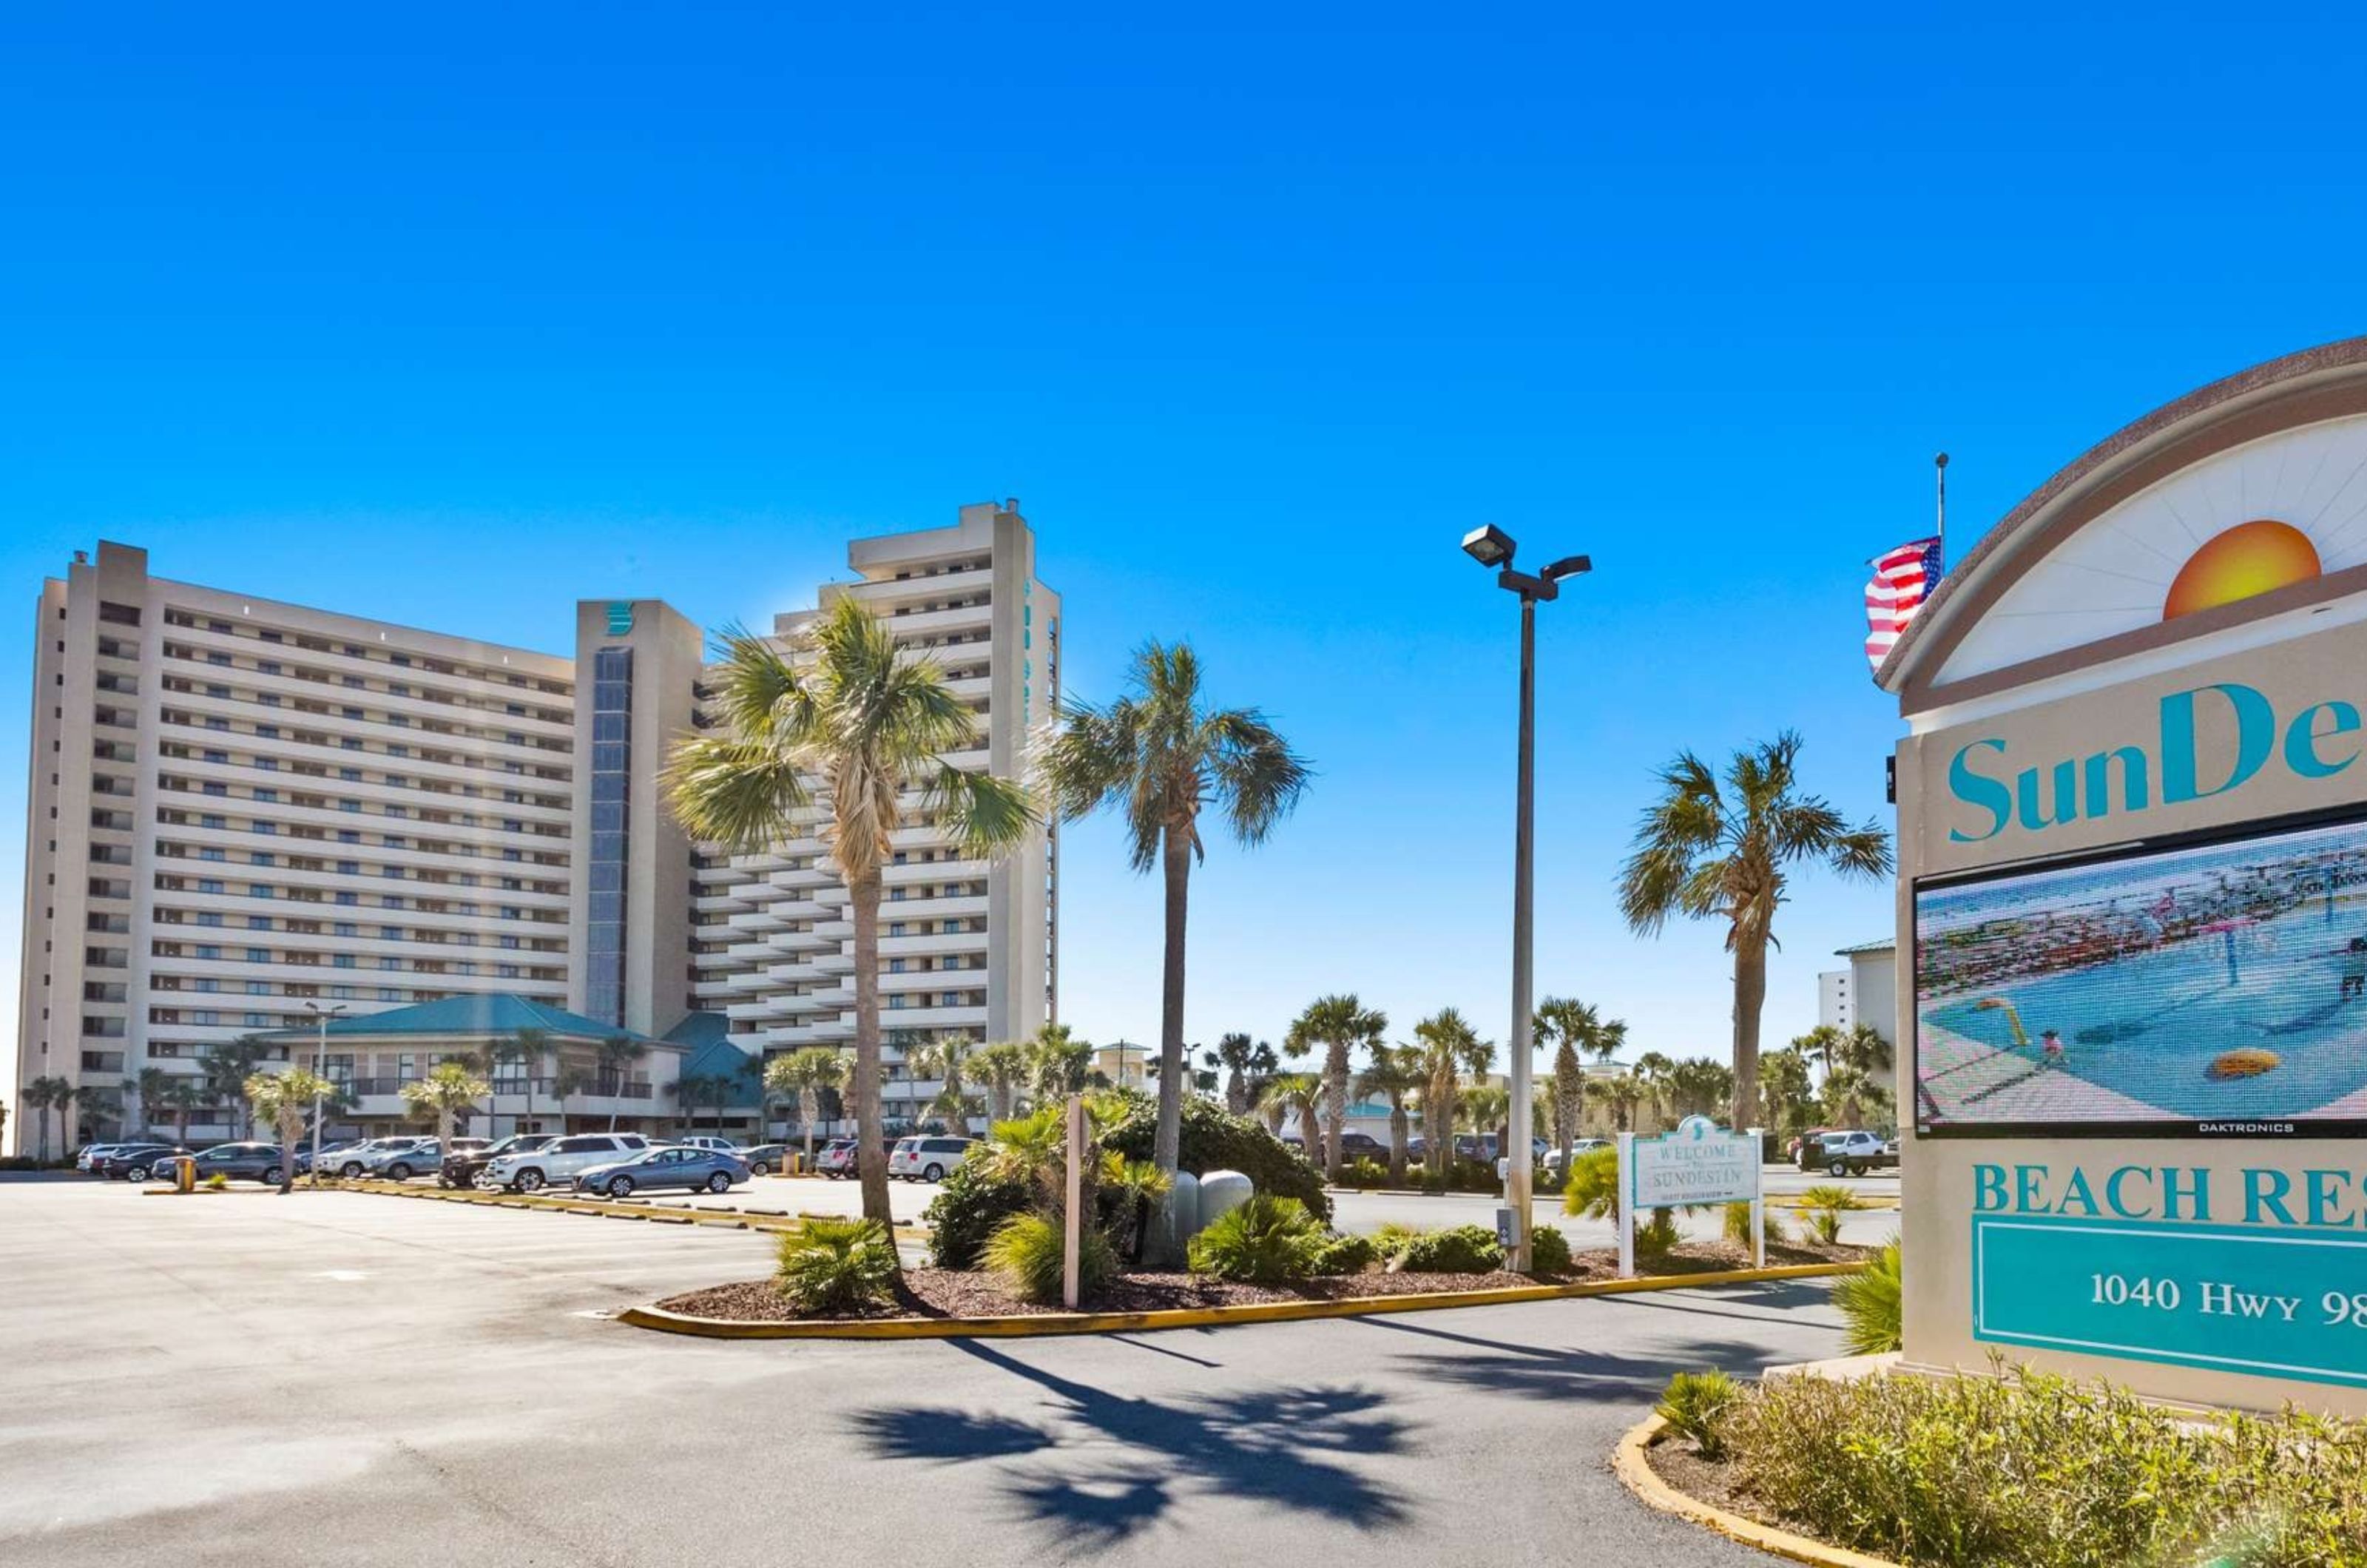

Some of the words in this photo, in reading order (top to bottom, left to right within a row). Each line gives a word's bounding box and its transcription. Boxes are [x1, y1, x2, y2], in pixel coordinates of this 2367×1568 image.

[2199, 1123, 2295, 1133] DAKTRONICS
[1659, 1144, 1735, 1160] WELCOME
[1653, 1169, 1741, 1188] SUNDESTIN
[1971, 1164, 2210, 1220] BEACH
[2242, 1169, 2367, 1226] RE
[2091, 1273, 2181, 1310] 1040
[2321, 1291, 2367, 1328] 98
